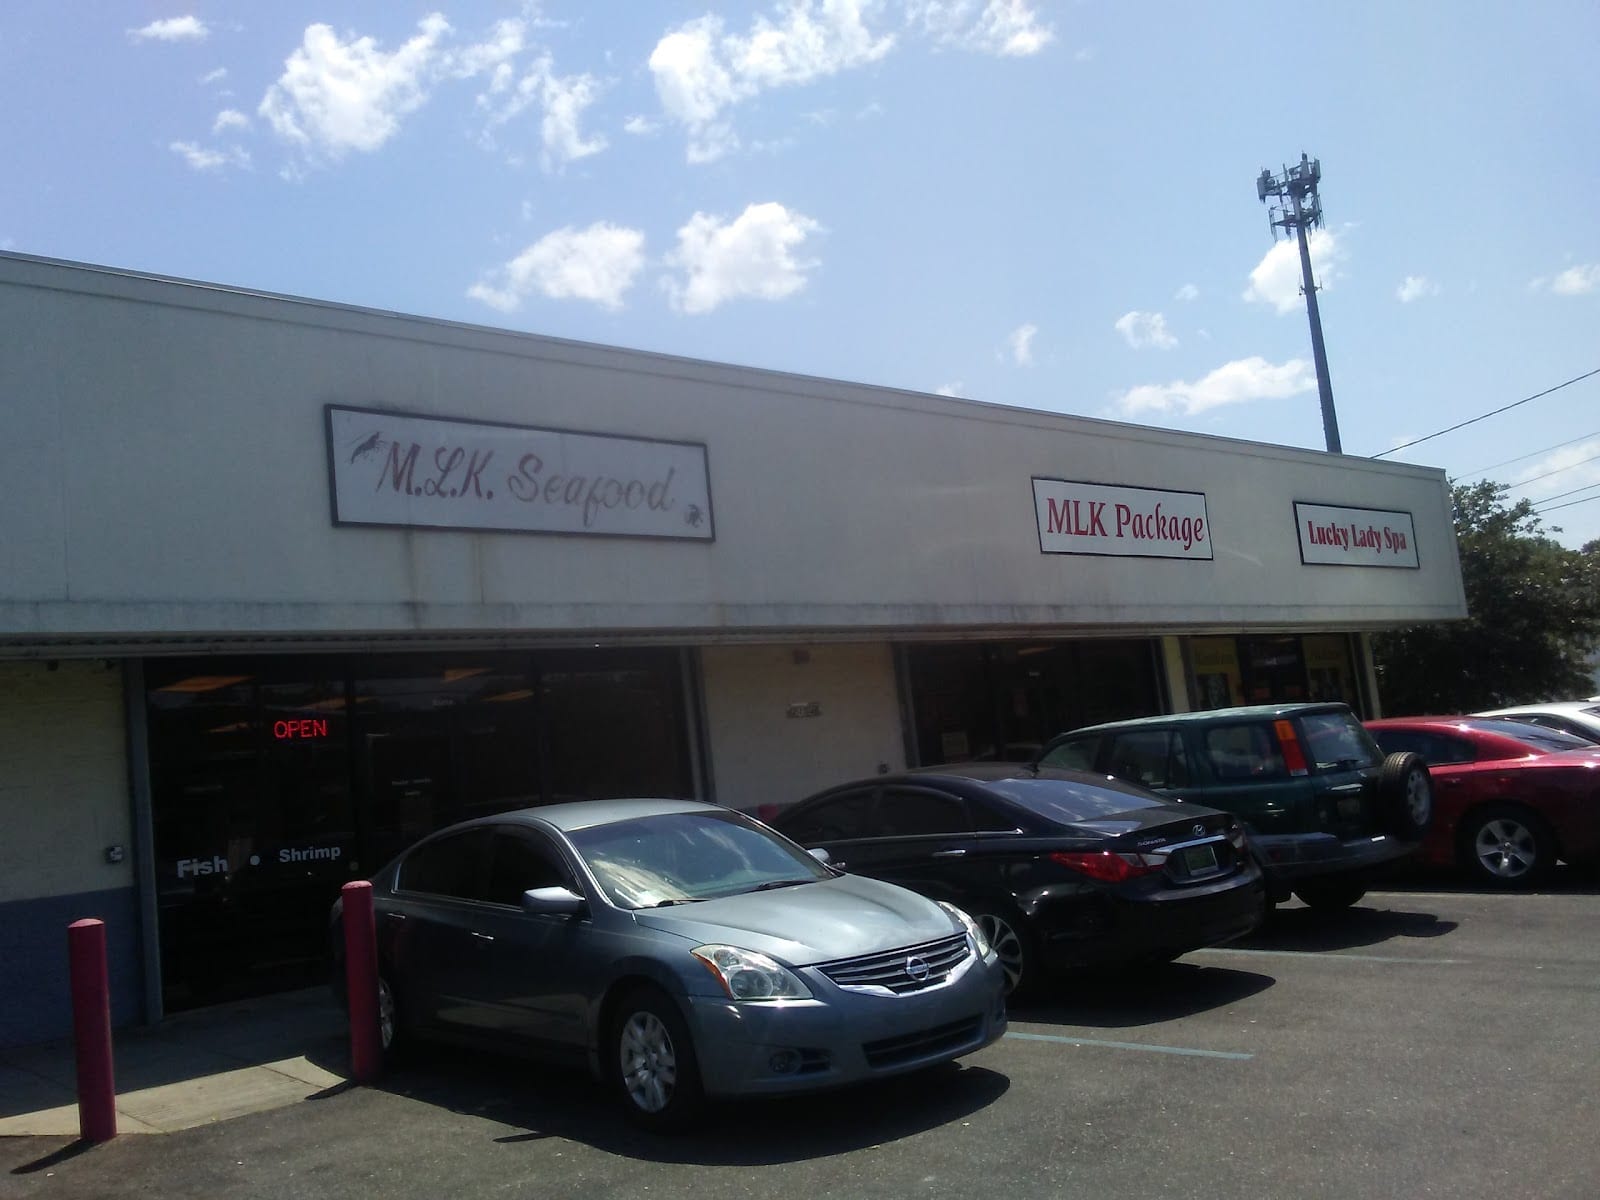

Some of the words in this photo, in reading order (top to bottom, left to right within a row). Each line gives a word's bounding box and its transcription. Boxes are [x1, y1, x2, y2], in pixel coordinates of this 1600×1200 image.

[375, 440, 495, 500] M.L.K.
[508, 453, 676, 528] Seafood
[1046, 497, 1108, 538] MLK
[1114, 501, 1204, 552] Package
[1307, 519, 1349, 552] Lucky
[1350, 523, 1382, 554] Lady
[1383, 525, 1407, 555] Spa
[273, 718, 328, 740] OPEN
[176, 854, 229, 879] Fish
[279, 845, 341, 865] Shrimp
